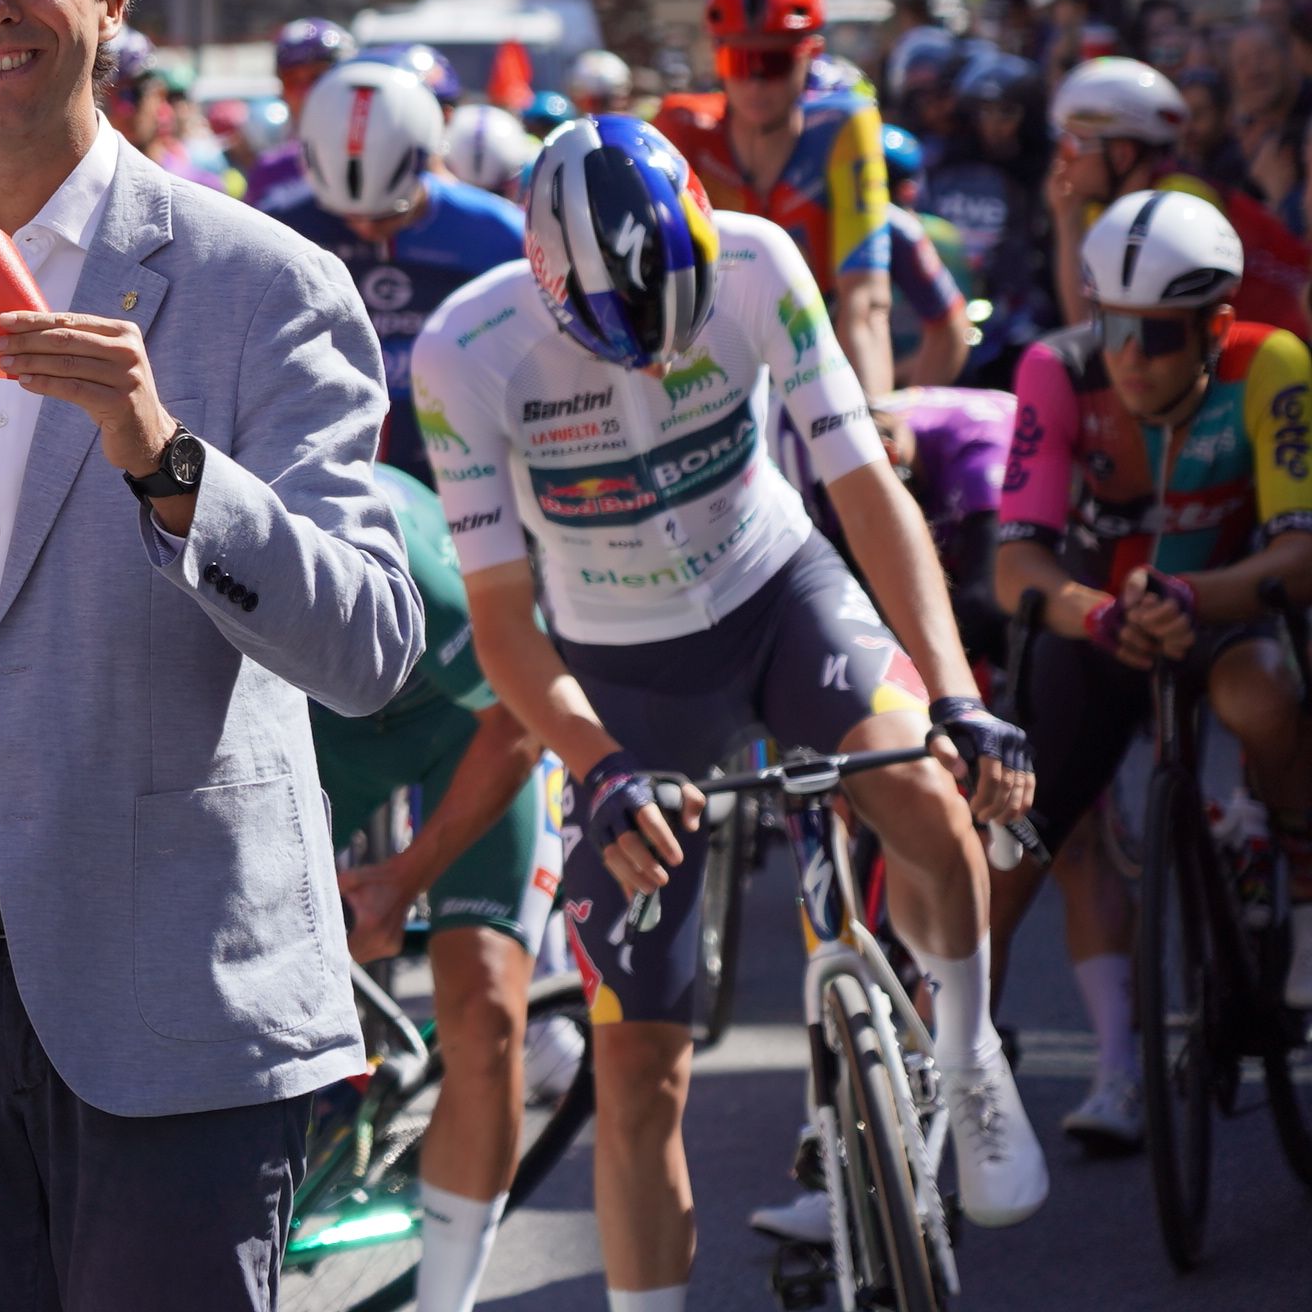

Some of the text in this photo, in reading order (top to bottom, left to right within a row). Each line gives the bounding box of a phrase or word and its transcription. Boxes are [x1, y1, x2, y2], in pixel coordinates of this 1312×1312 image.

[523, 384, 614, 423] Santini
[660, 387, 743, 432] plenitude
[548, 422, 600, 443] VUELTA
[602, 416, 620, 434] 25
[655, 421, 755, 489] BORA
[539, 491, 657, 517] Red Bull
